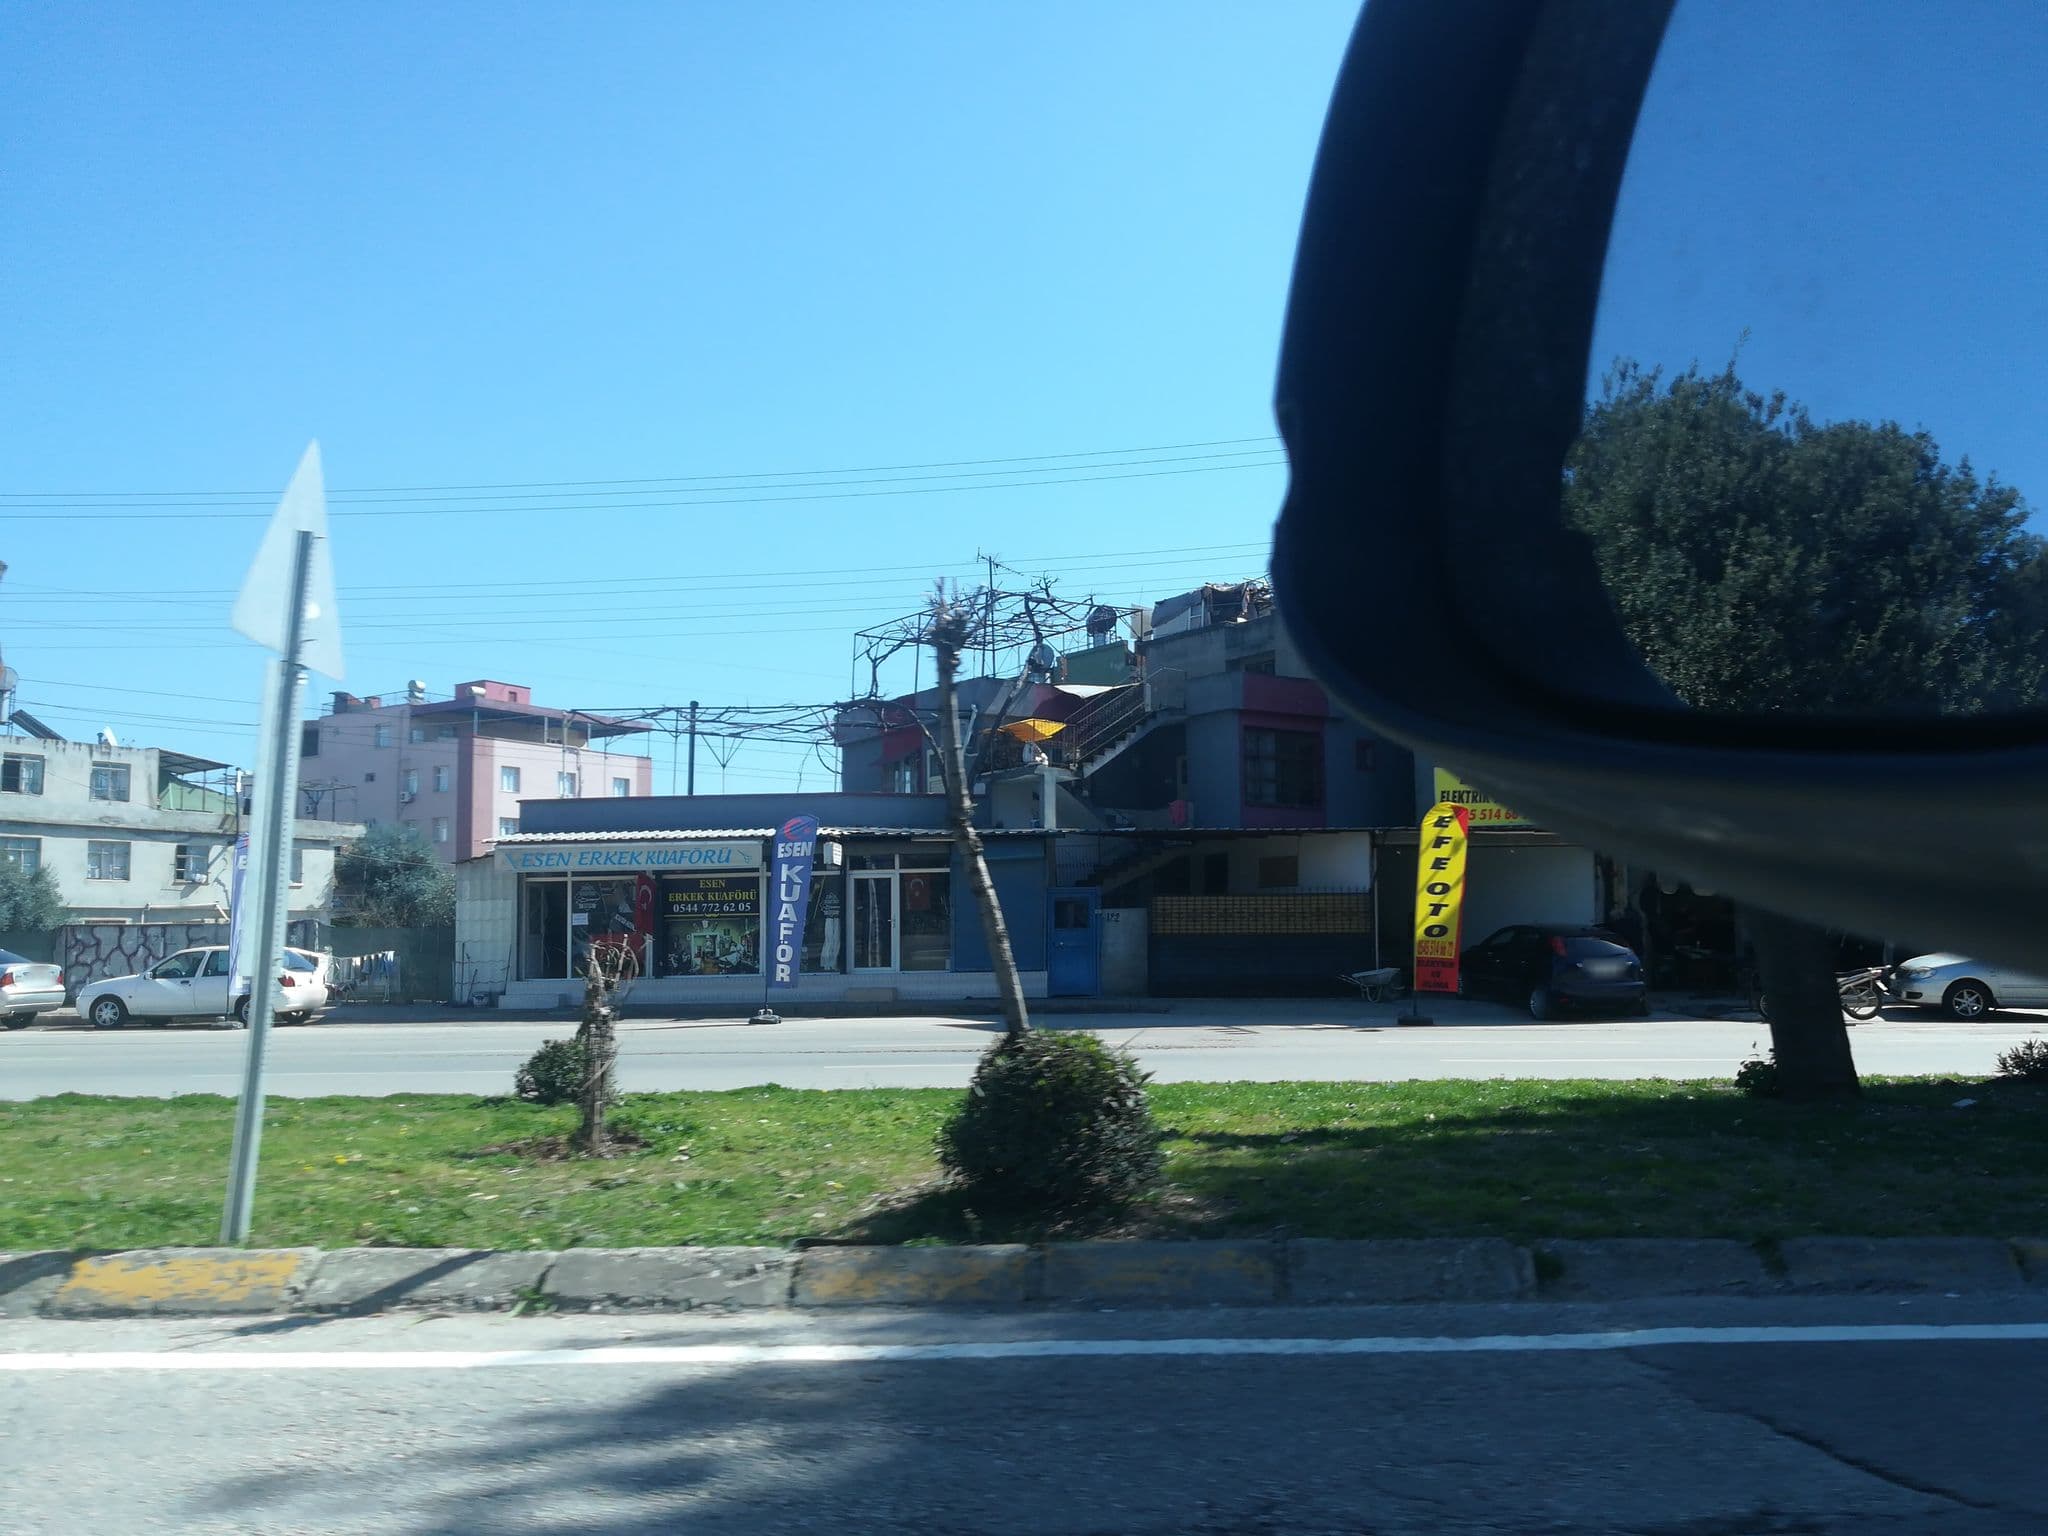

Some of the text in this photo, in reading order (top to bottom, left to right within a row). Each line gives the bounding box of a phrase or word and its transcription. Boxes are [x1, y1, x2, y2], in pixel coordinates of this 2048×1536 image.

[1479, 808, 1502, 820] 514
[777, 841, 813, 859] ESEN
[521, 851, 572, 867] ESEN
[579, 850, 644, 866] ERKEK
[699, 879, 726, 889] ESEN
[668, 889, 757, 902] ERKEK KUAFÖRÜ
[673, 902, 751, 913] 0544 772 62 05
[775, 863, 805, 982] KUAFÖR
